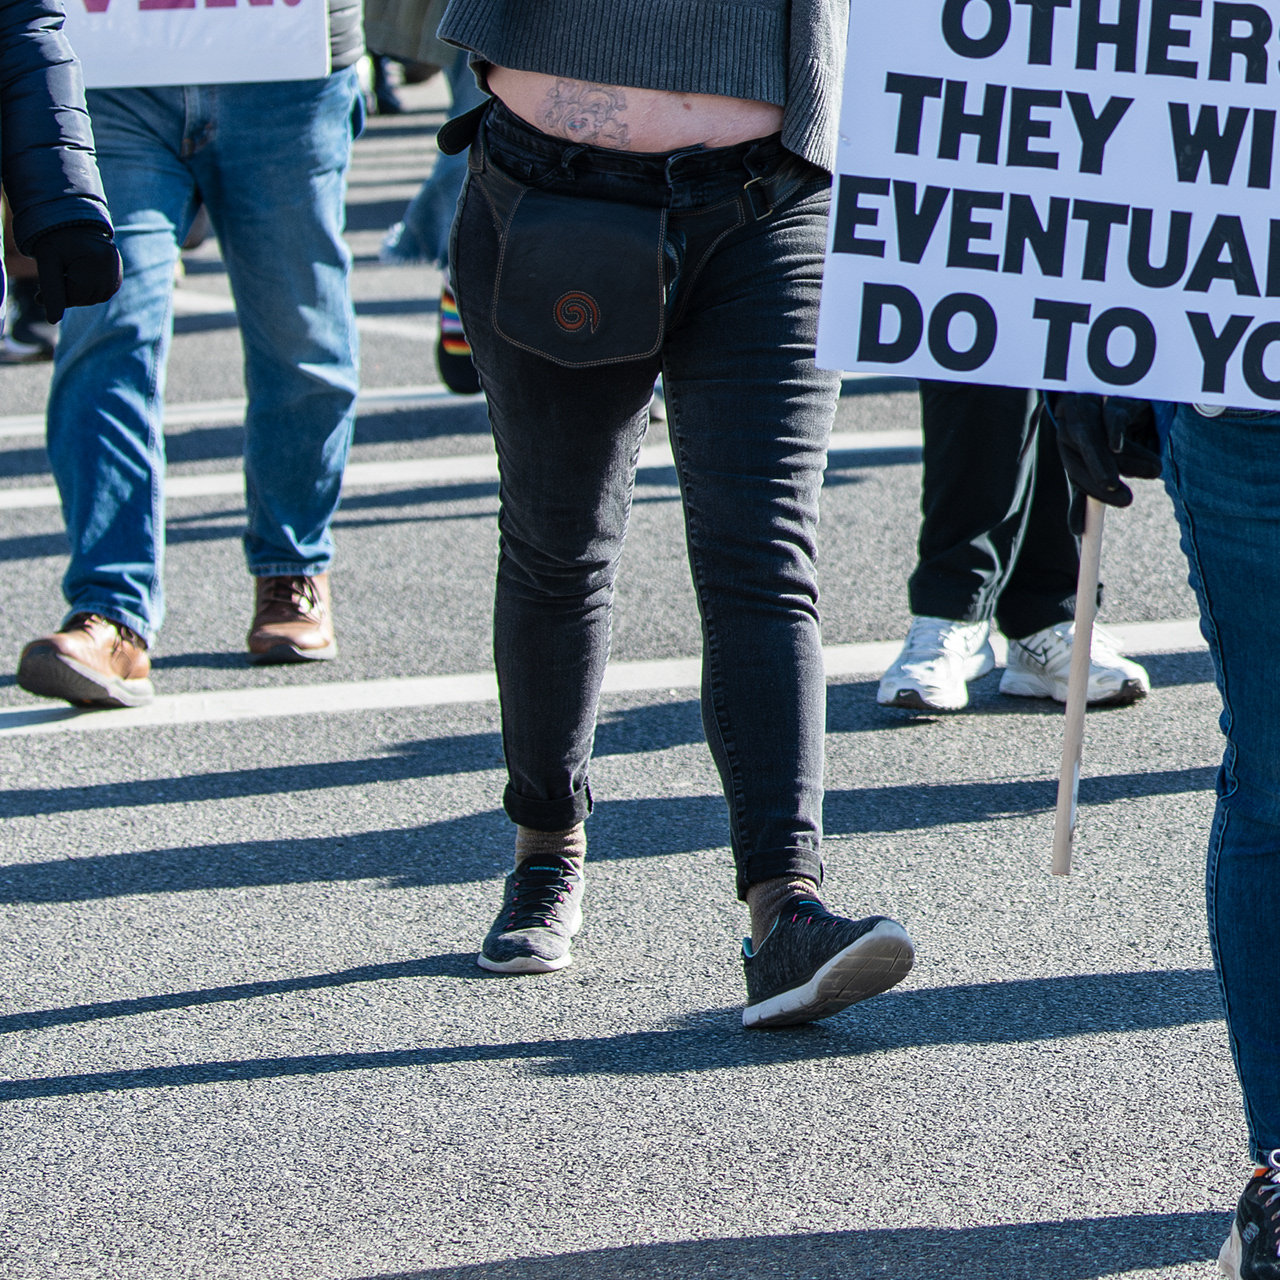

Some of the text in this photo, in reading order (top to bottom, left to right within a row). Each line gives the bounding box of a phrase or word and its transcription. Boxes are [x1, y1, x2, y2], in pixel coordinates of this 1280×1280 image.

[885, 71, 1135, 175] THEY
[856, 282, 998, 373] DO
[1032, 298, 1157, 387] TO
